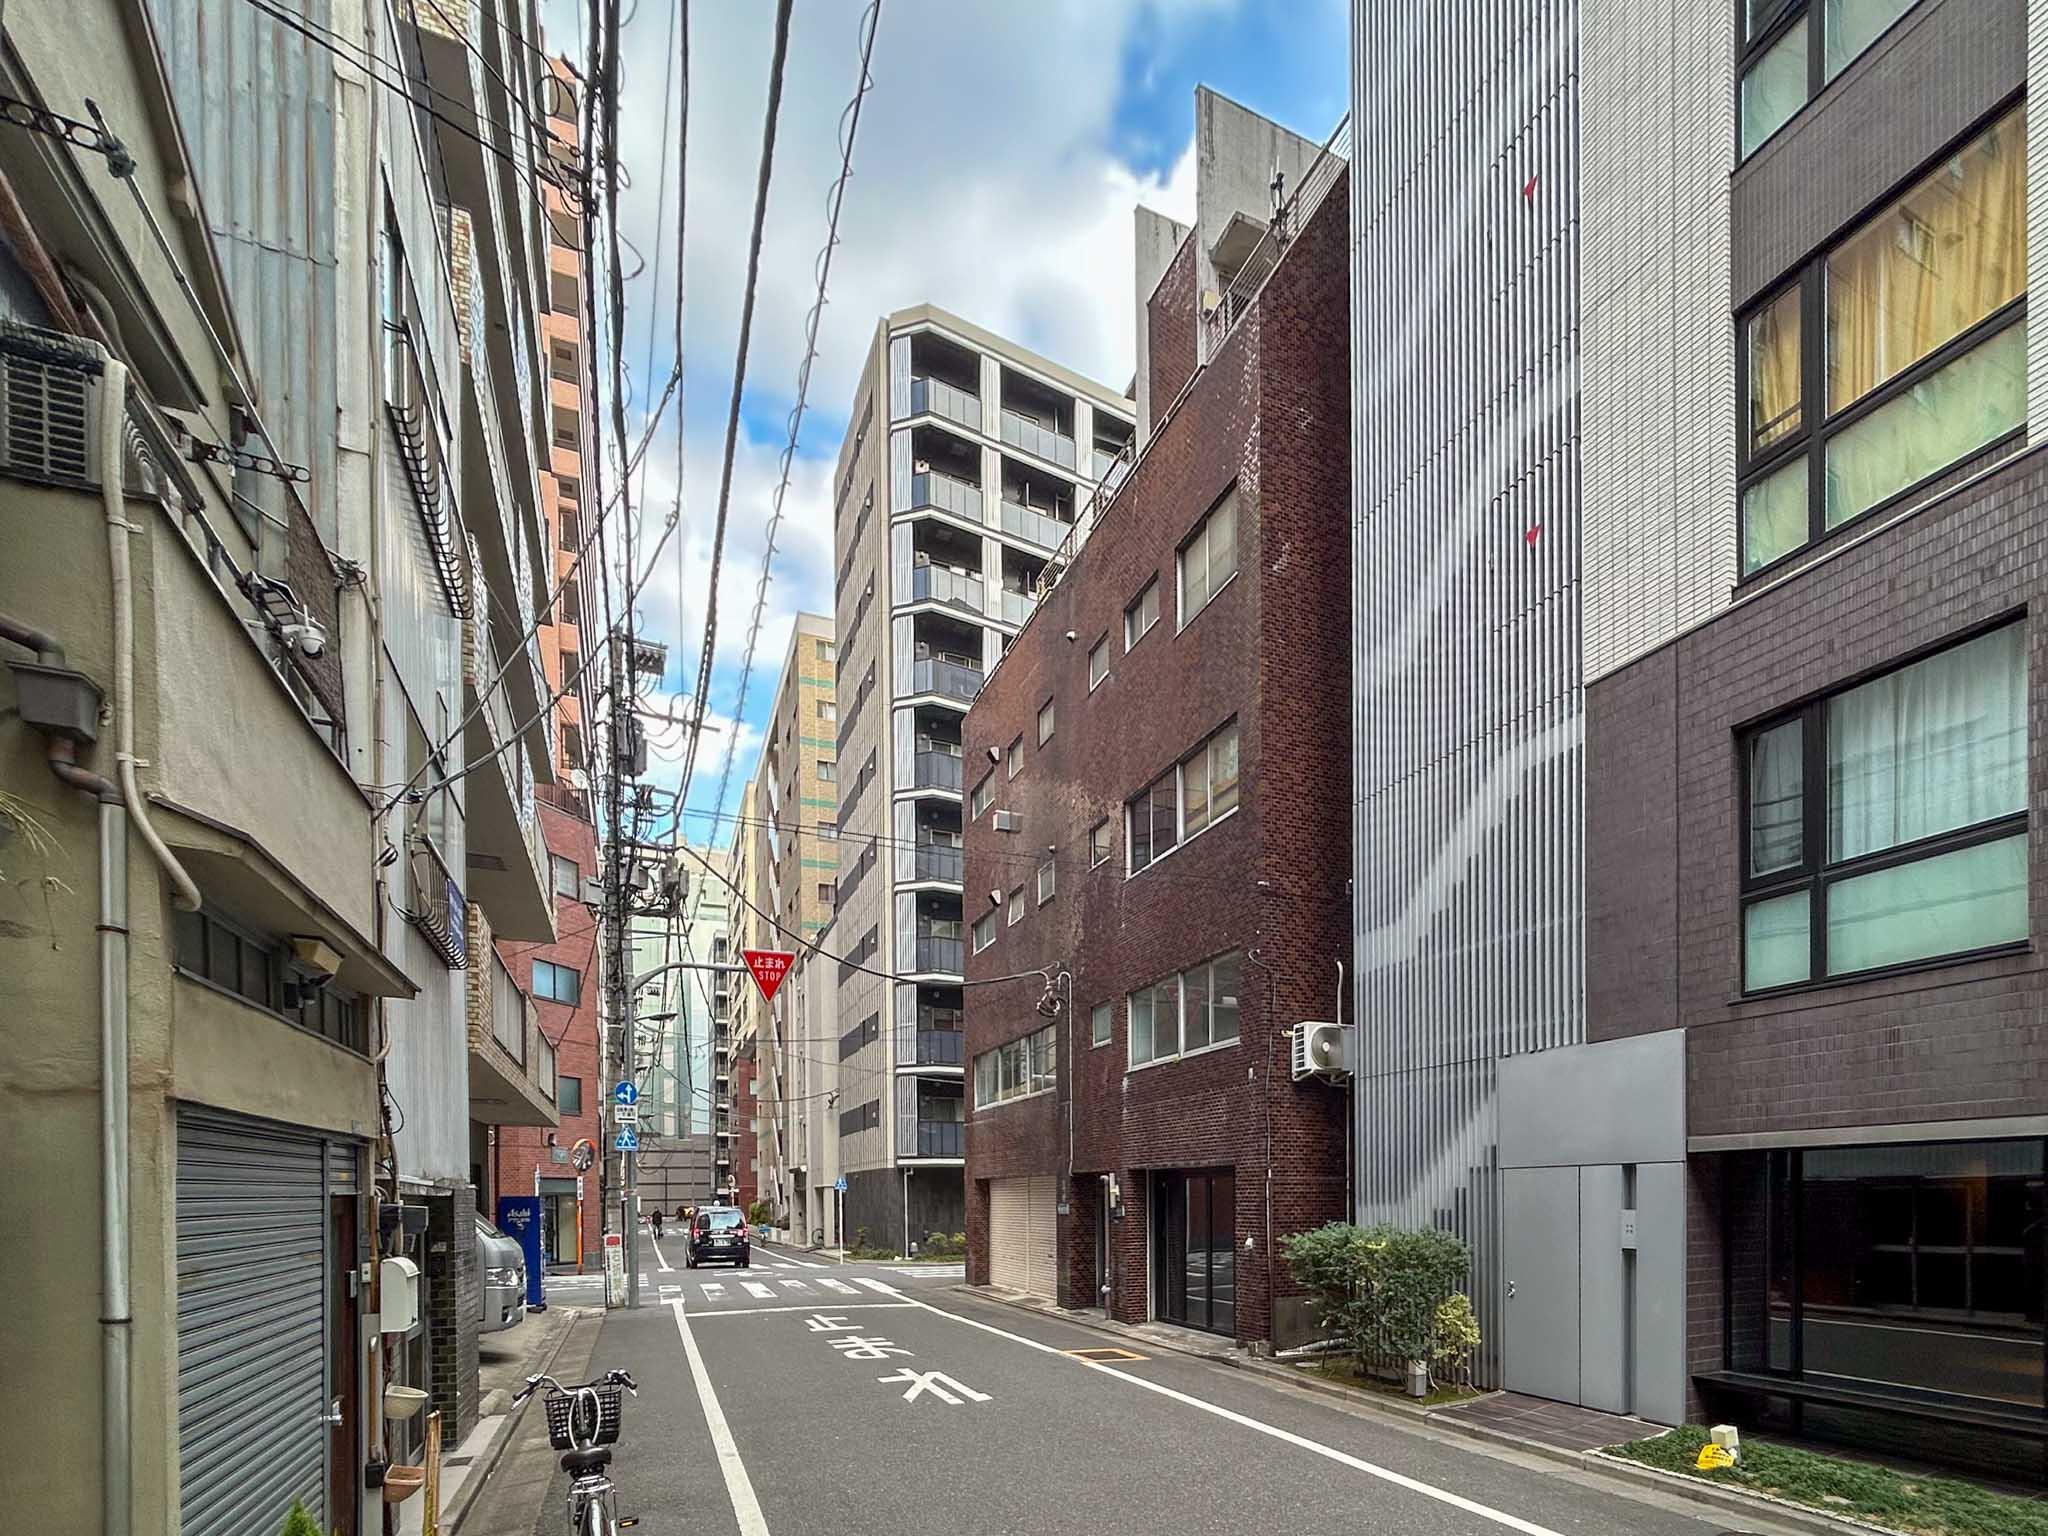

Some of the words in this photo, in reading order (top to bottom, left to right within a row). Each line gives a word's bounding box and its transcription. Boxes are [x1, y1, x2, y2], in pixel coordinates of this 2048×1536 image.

[753, 956, 786, 969] 止まれ
[758, 970, 782, 982] STOP
